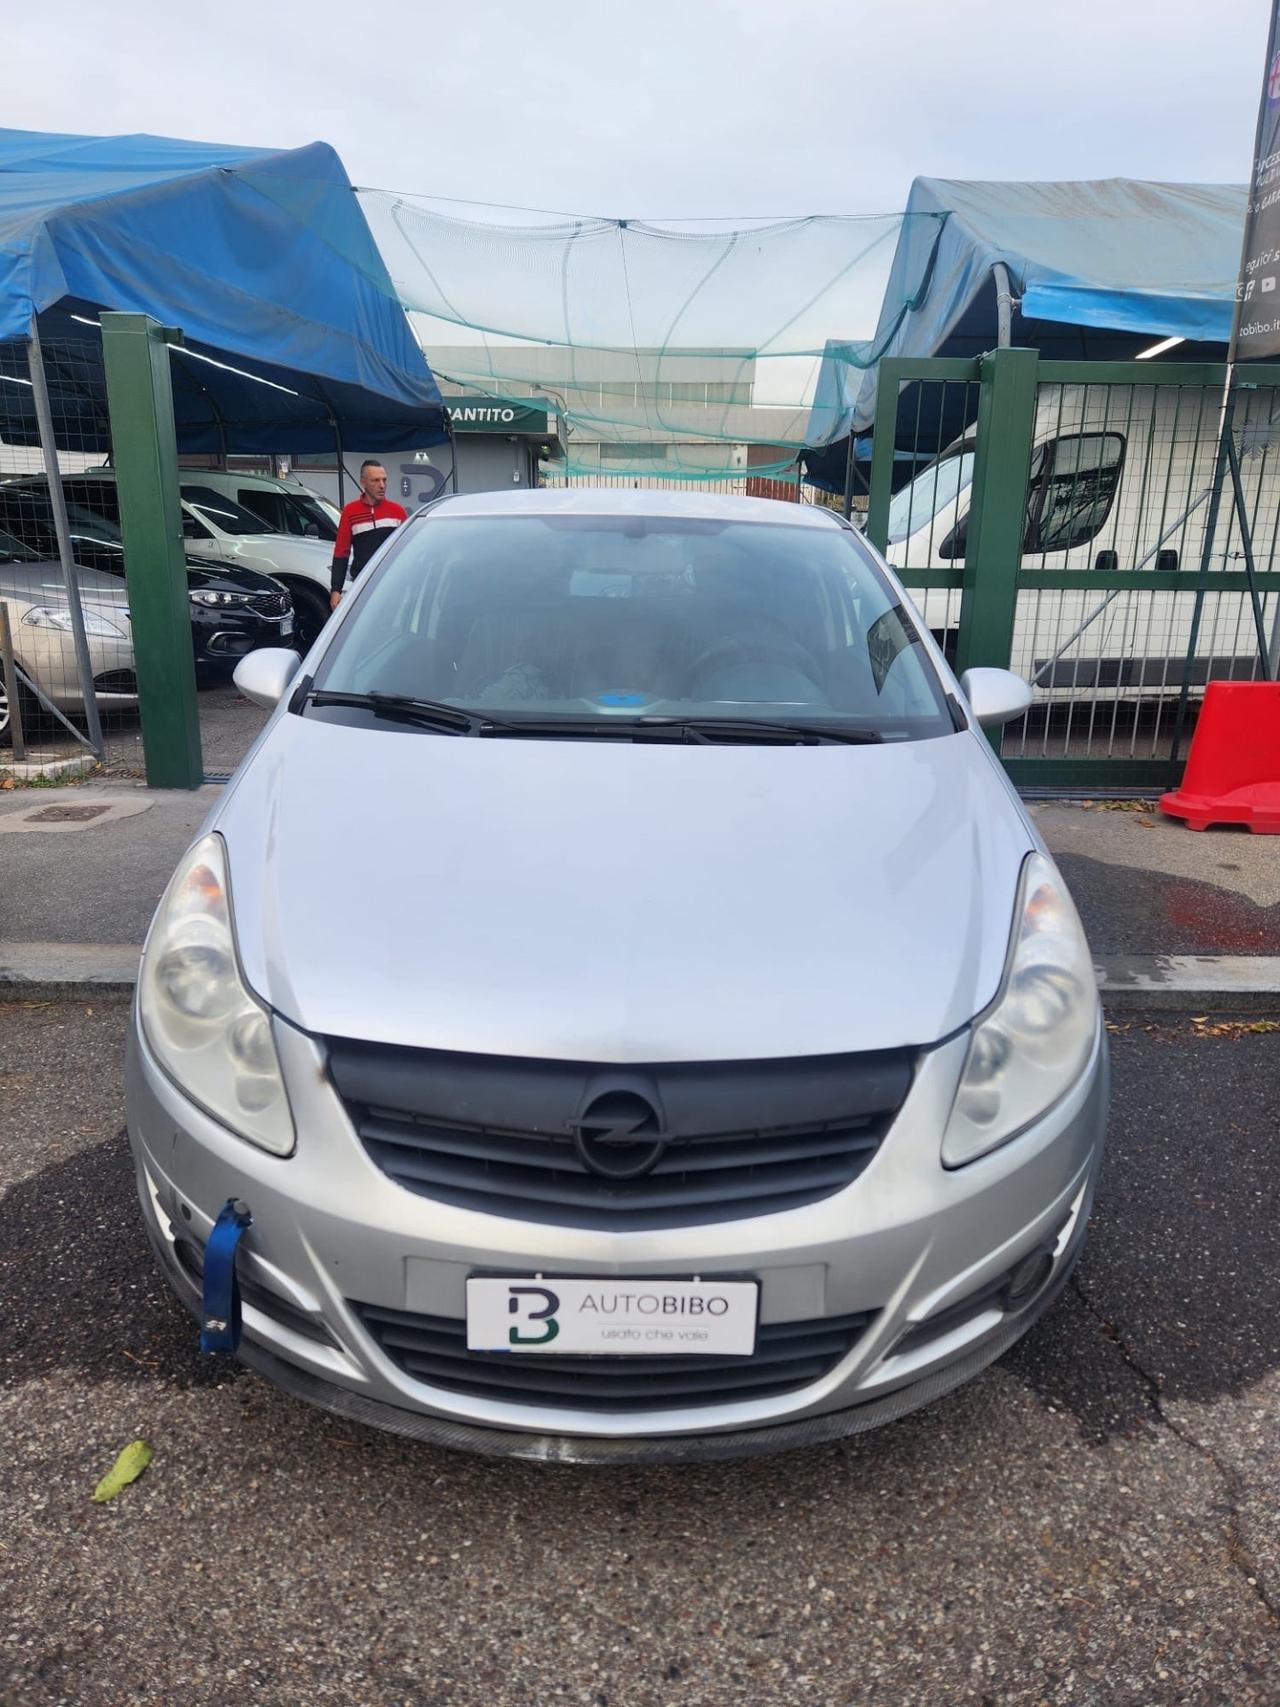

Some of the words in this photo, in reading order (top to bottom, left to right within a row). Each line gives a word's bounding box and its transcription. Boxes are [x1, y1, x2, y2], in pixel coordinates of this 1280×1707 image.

[579, 1294, 729, 1316] AUTOBIBO
[601, 1328, 641, 1340] usato
[645, 1329, 674, 1340] che
[679, 1330, 709, 1342] vale
